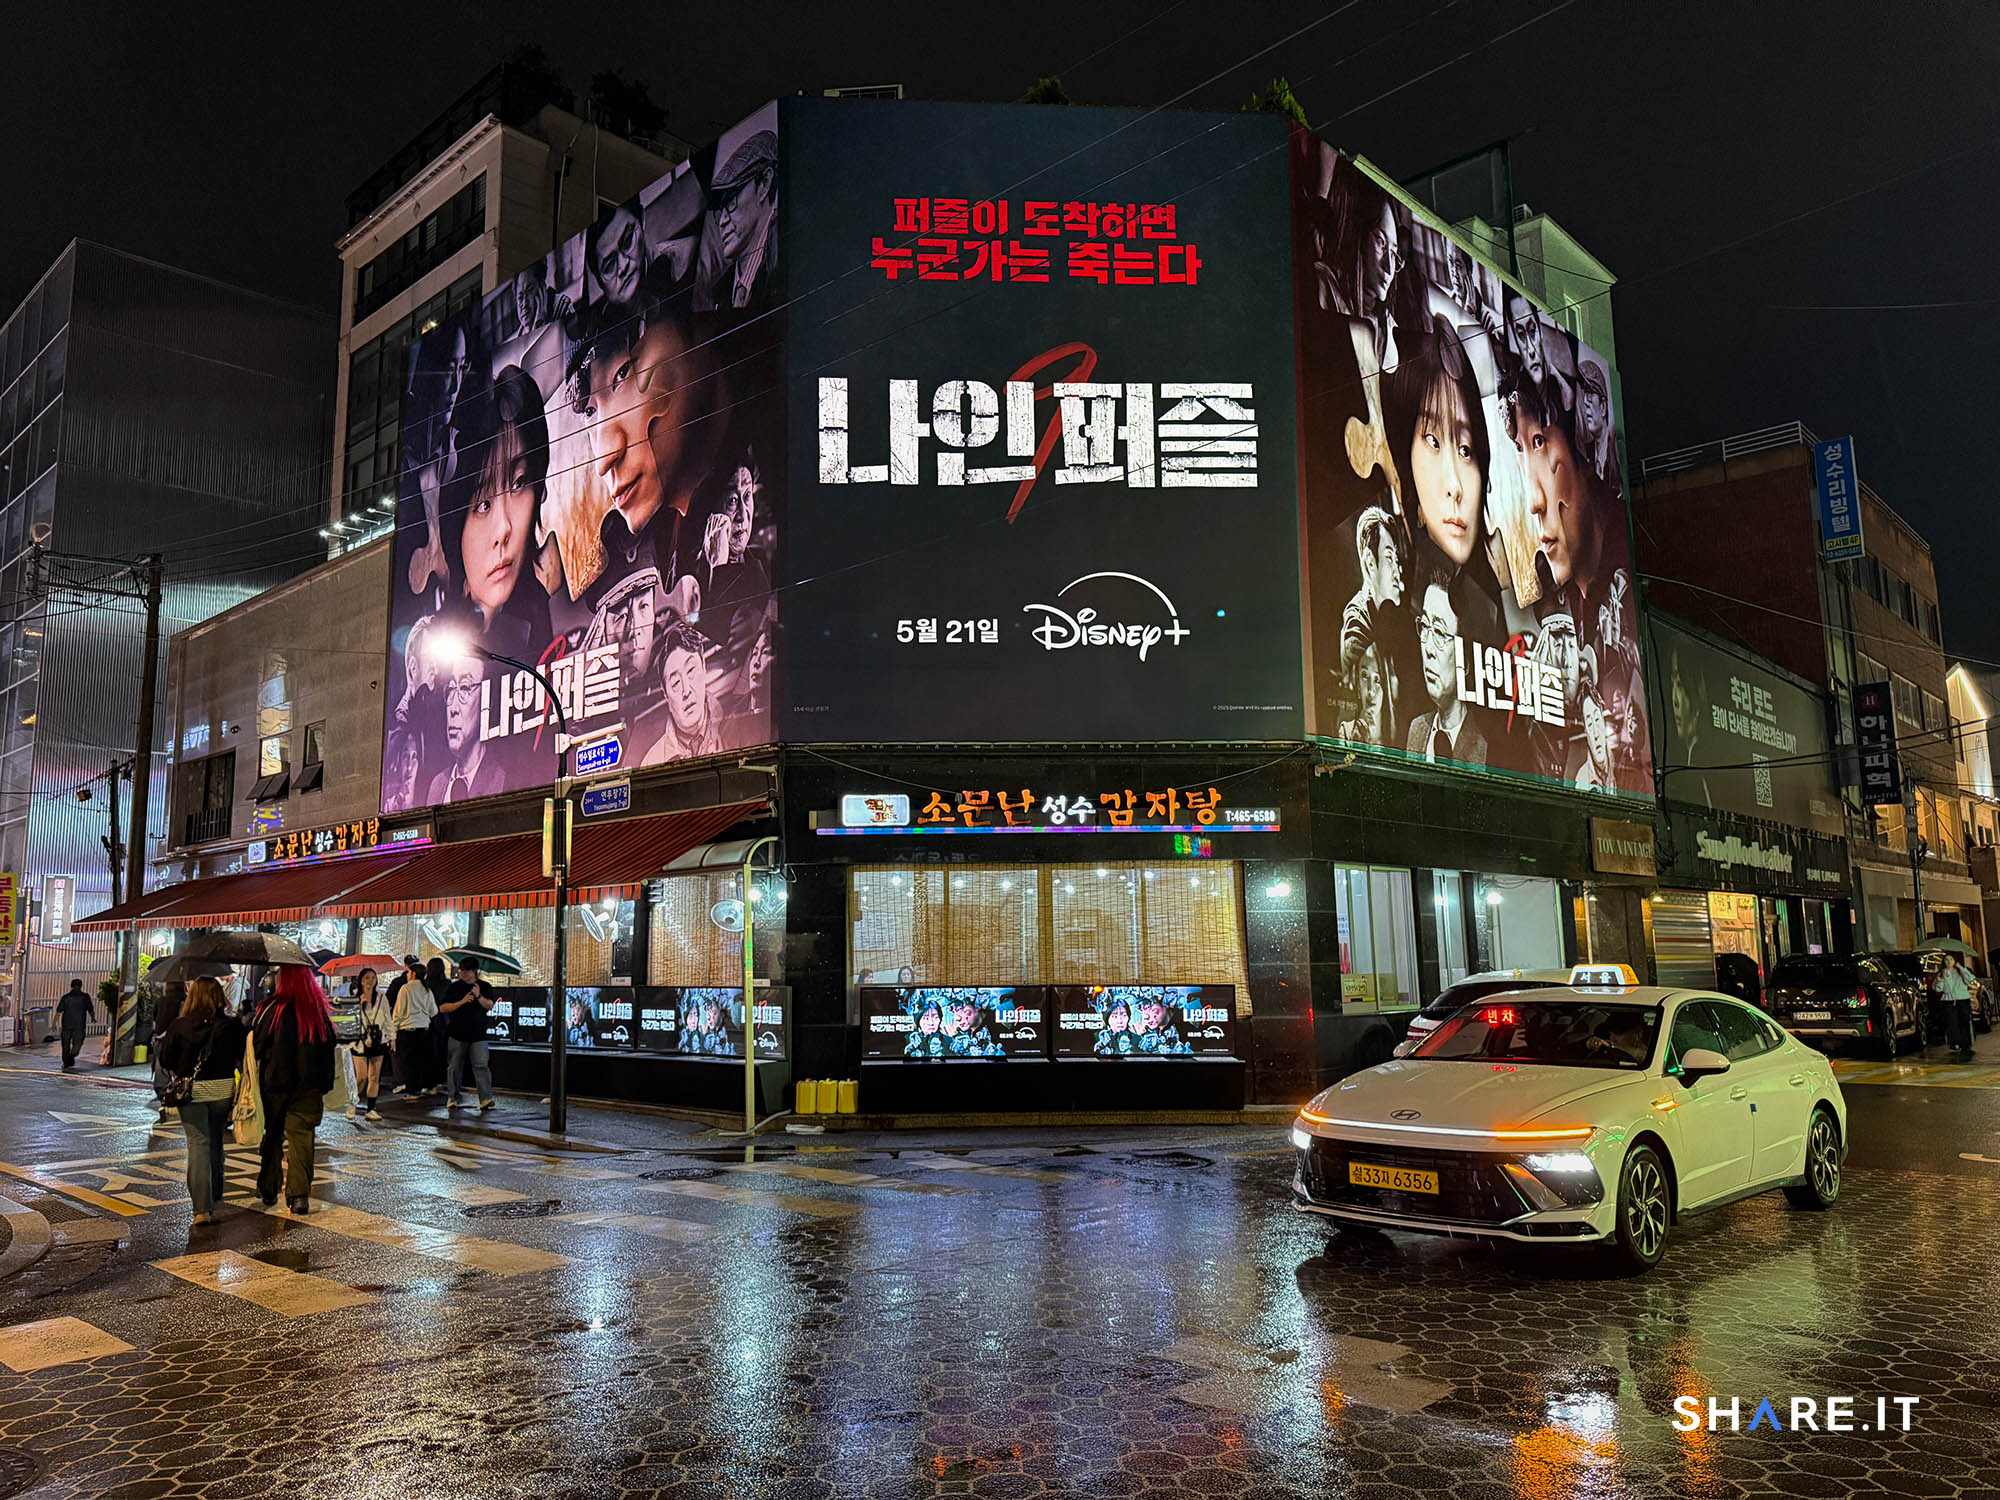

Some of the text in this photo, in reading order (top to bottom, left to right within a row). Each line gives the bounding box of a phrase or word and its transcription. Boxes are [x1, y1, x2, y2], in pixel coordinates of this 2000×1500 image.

[893, 197, 1178, 240] 퍼즐이 도착하면
[870, 237, 1203, 286] 누군가는 죽는다
[1823, 443, 1851, 533] 성수리빙텔
[896, 617, 1000, 643] 5월 21일
[1023, 600, 1191, 662] Disney+
[1730, 676, 1752, 714] 추리
[1712, 704, 1728, 731] 같이
[1728, 711, 1750, 738] 단서를
[917, 787, 1222, 827] 소문난 성수 감자탕
[1224, 809, 1276, 823] T:465-6580
[273, 817, 380, 860] 소문난 성수 감자탕
[1580, 972, 1612, 984] 서울
[1393, 1171, 1432, 1191] 6356
